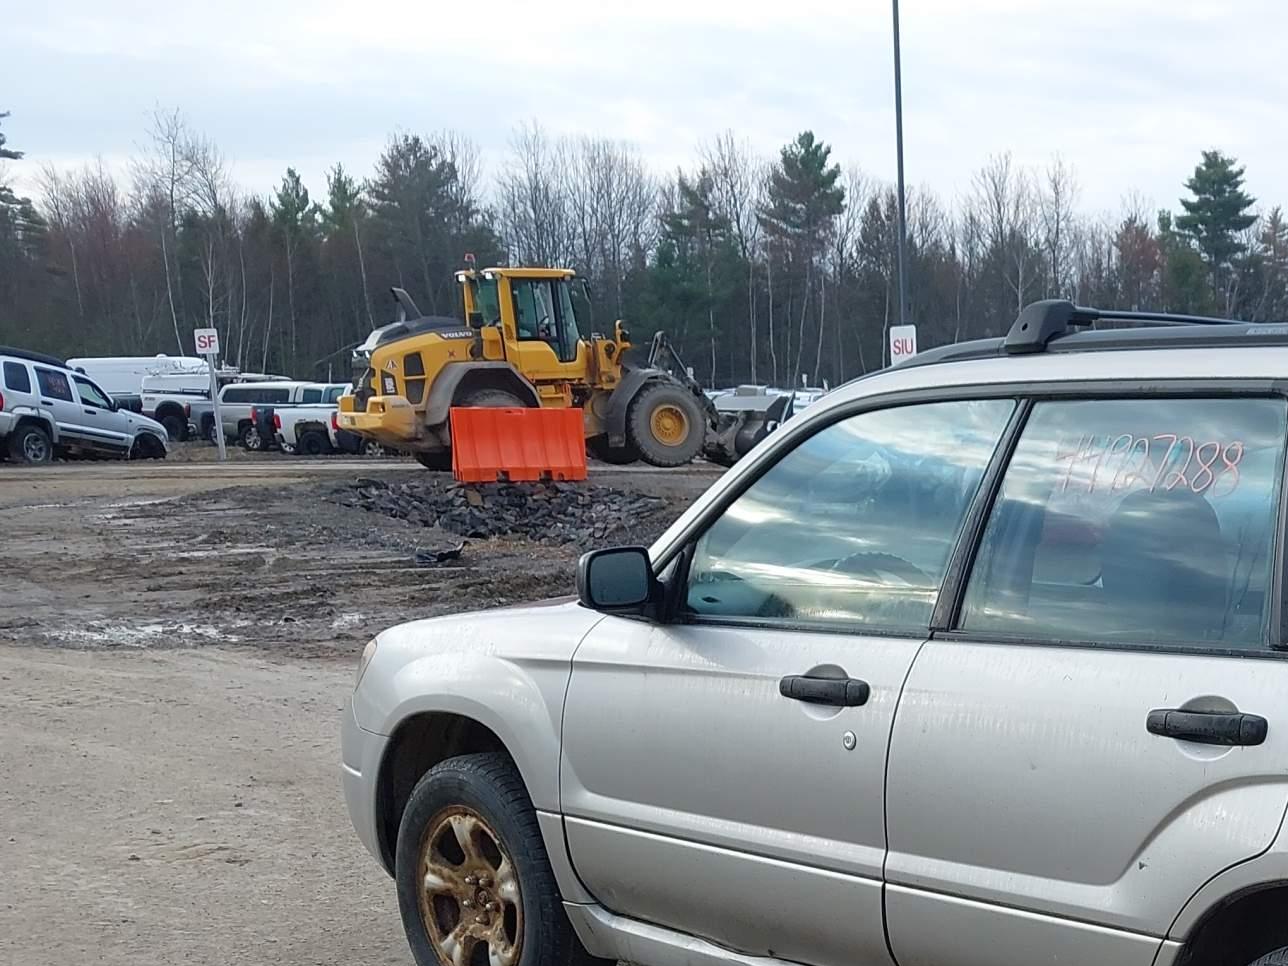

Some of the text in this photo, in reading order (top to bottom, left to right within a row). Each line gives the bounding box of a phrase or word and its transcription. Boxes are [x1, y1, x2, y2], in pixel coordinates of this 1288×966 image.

[197, 334, 216, 349] SF
[441, 331, 472, 339] VOLVO
[893, 338, 914, 355] SIU
